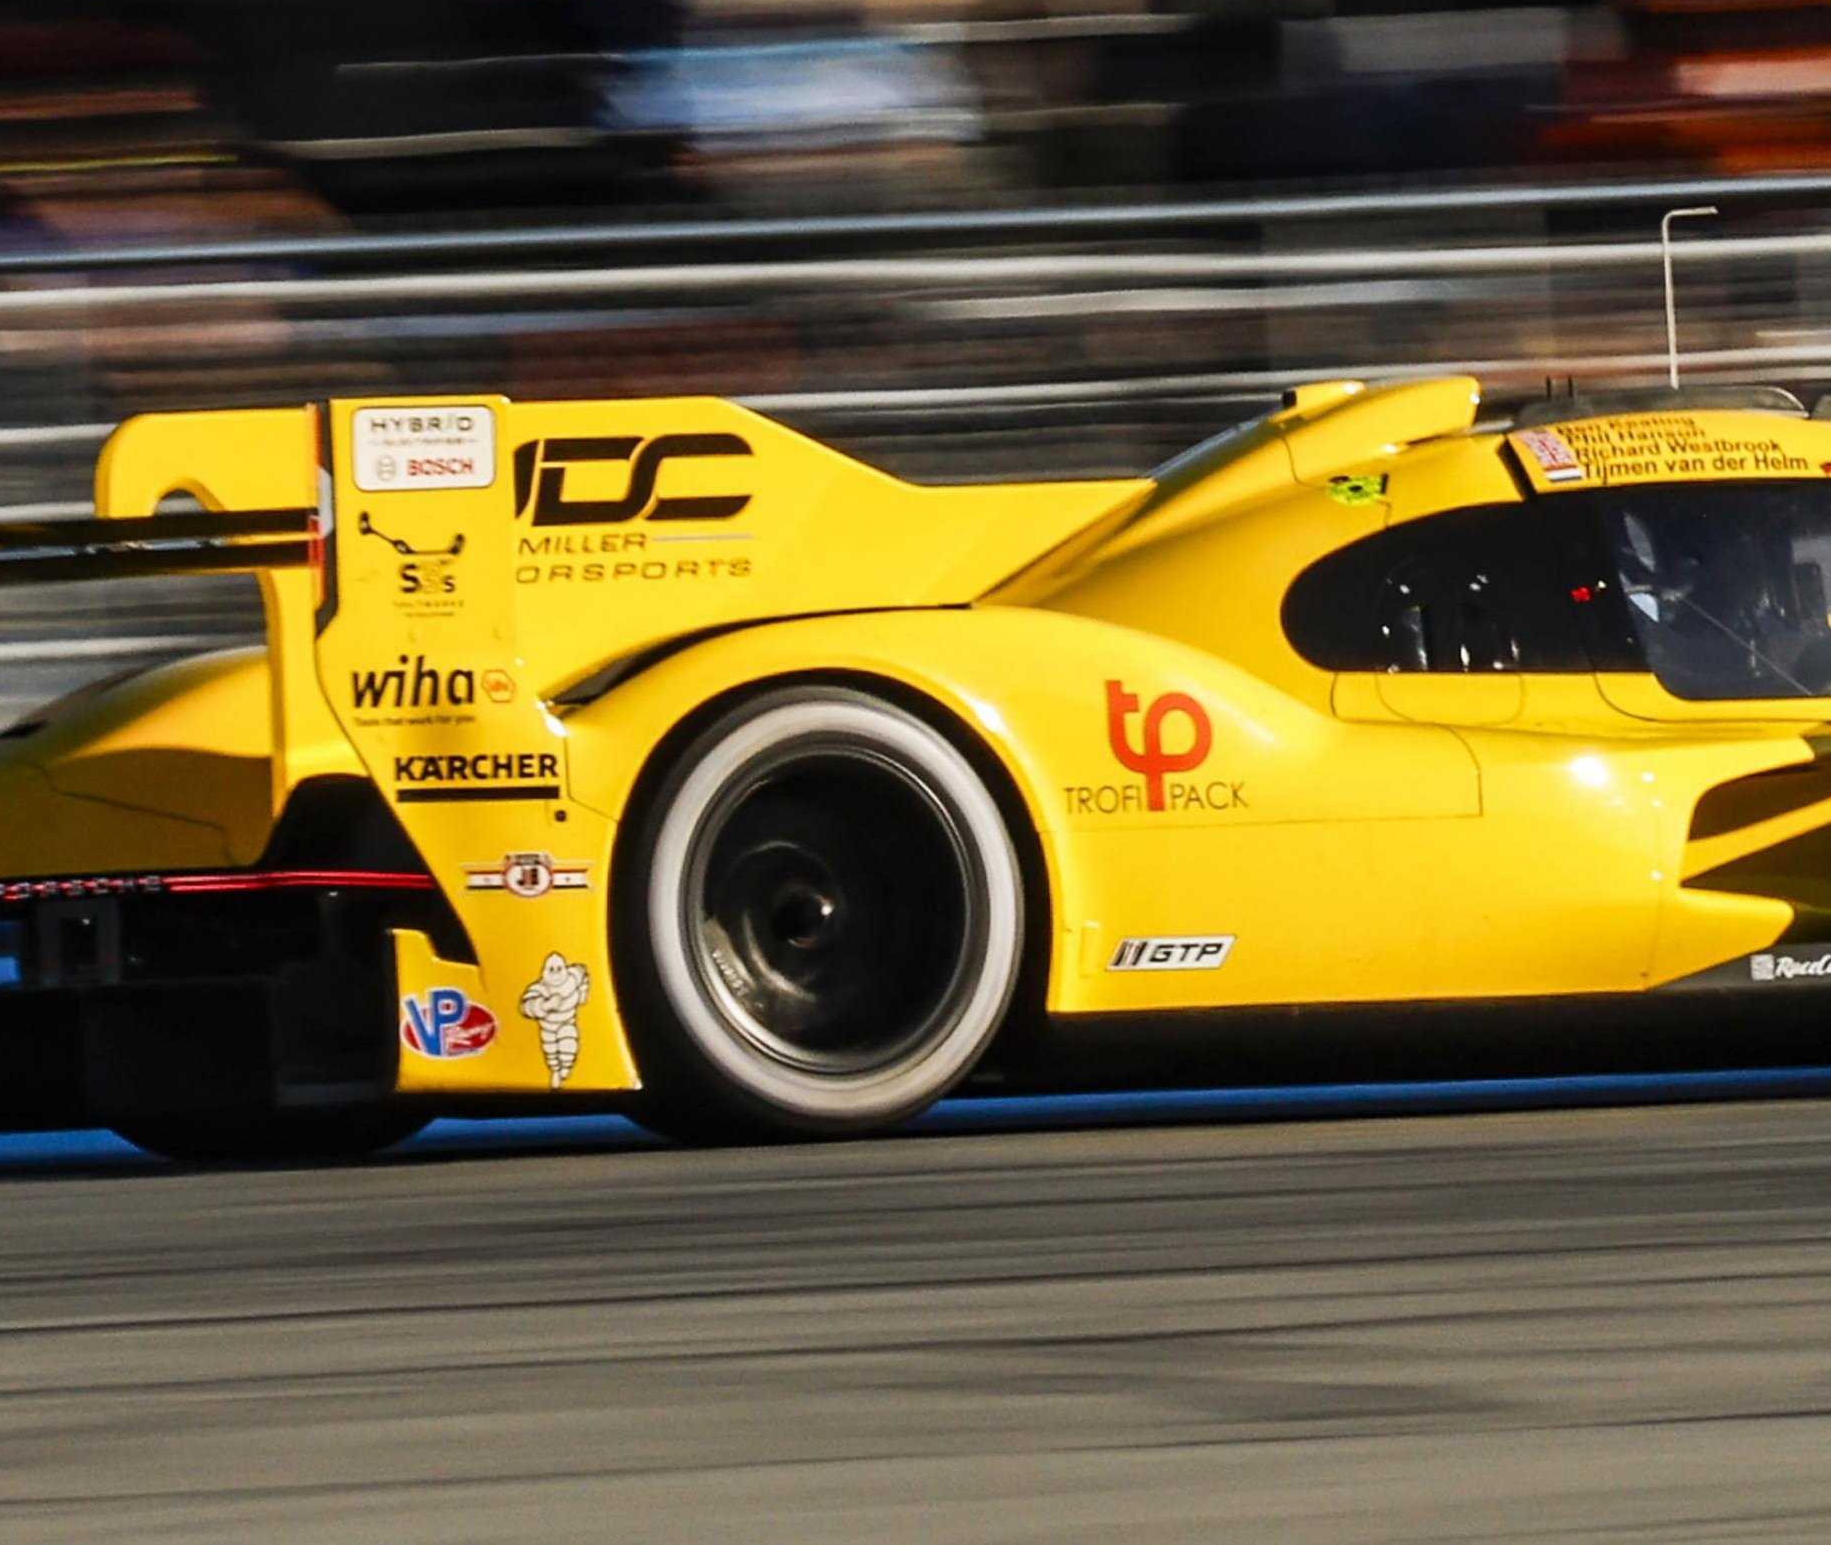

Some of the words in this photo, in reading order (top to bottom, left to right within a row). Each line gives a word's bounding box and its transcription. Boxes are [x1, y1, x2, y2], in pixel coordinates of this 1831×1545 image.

[1574, 440, 1661, 464] Richard
[1666, 439, 1785, 454] Westbrook
[407, 457, 474, 476] BOSCH
[1581, 458, 1658, 486] Tijmen
[1664, 457, 1705, 472] van
[1712, 456, 1747, 471] der
[1753, 453, 1810, 471] Helm
[518, 534, 648, 556] MILLER
[352, 654, 474, 708] wiha
[1063, 784, 1142, 815] TROFI
[1169, 781, 1249, 811] PACK
[1149, 943, 1223, 963] GTP
[404, 988, 465, 1057] VP
